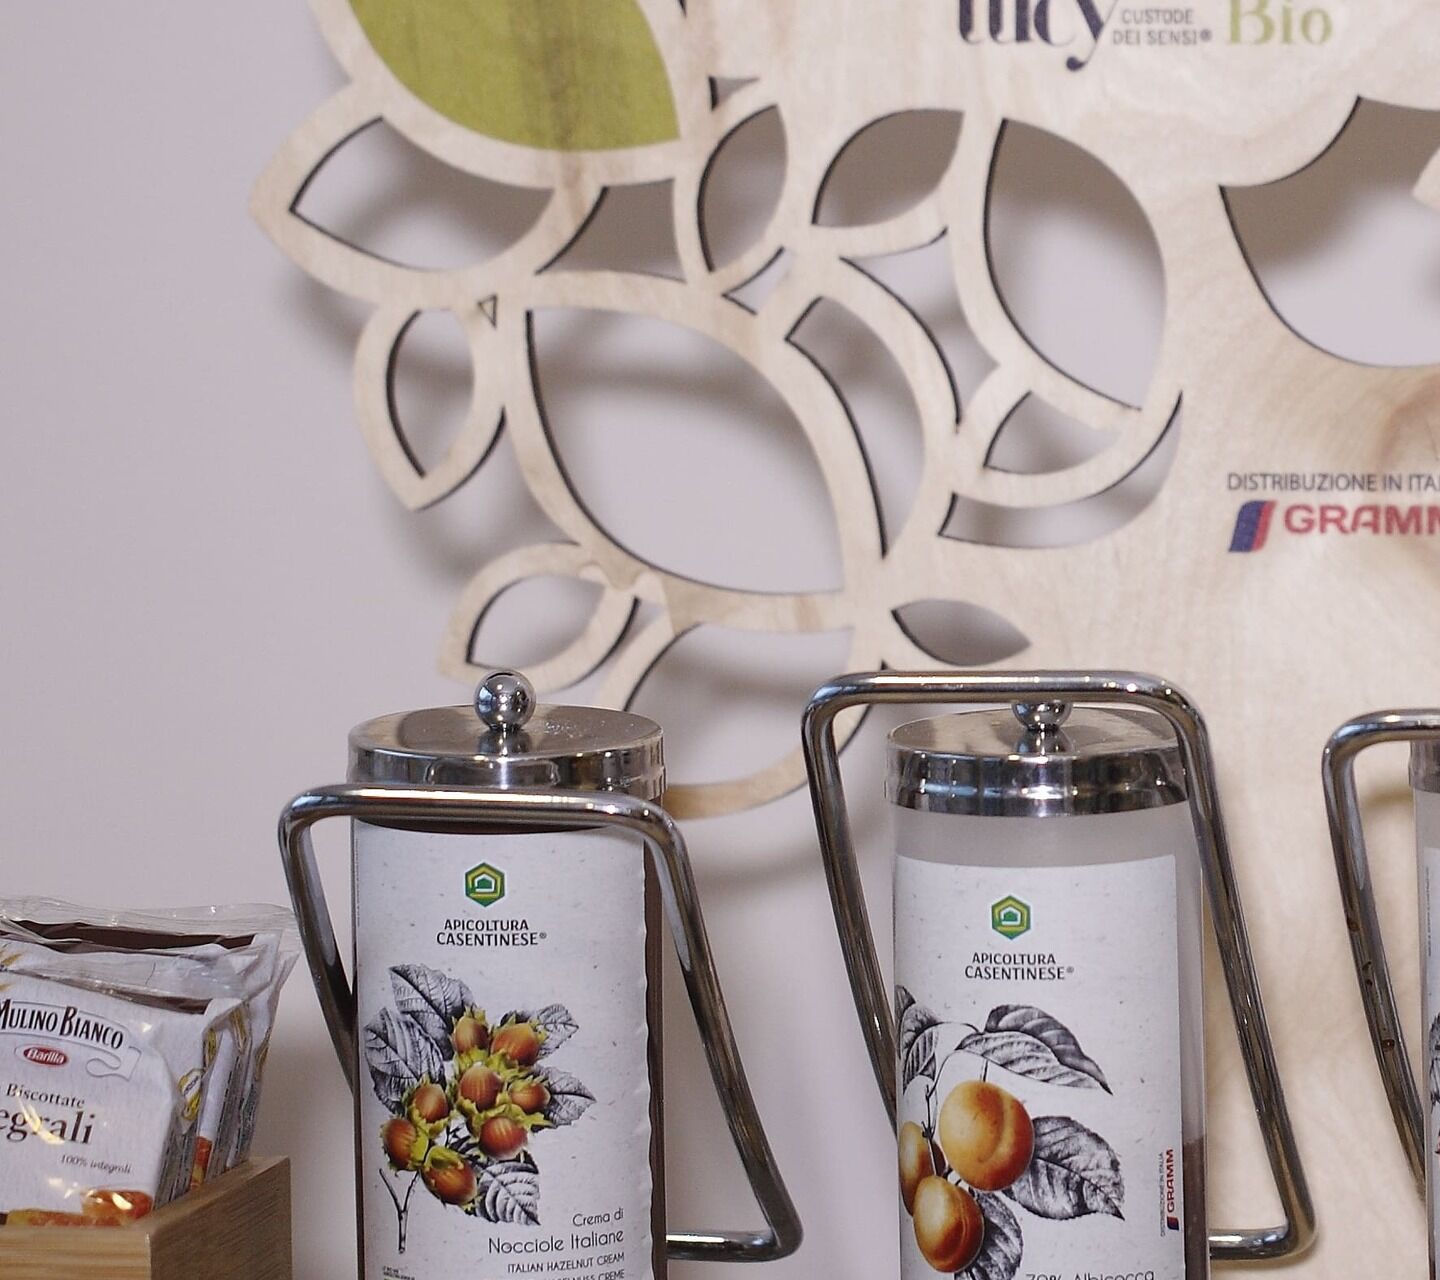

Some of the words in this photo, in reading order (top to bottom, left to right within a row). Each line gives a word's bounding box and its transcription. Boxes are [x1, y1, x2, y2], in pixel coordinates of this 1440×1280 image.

[1121, 8, 1194, 25] CUSTODE
[1112, 30, 1141, 46] DEI
[1147, 30, 1198, 46] SENSI
[1227, 472, 1377, 492] DISTRIBUZIONE
[1383, 474, 1402, 491] IN
[443, 918, 529, 932] APICOLTURA
[436, 931, 539, 947] CASENTINESE
[971, 952, 1056, 965] APICOLTURA
[965, 965, 1065, 980] CASENTINESE
[59, 1006, 124, 1050] BIANCO
[6, 1083, 85, 1109] Biscottate
[1166, 1148, 1174, 1213] GRAMM
[572, 1213, 610, 1227] Crema
[614, 1208, 624, 1220] di
[488, 1235, 564, 1254] Nocciole
[571, 1230, 624, 1250] Italiane
[507, 1263, 543, 1273] ITALIAN
[547, 1257, 593, 1271] HAZELNUT
[596, 1252, 625, 1266] CREAM
